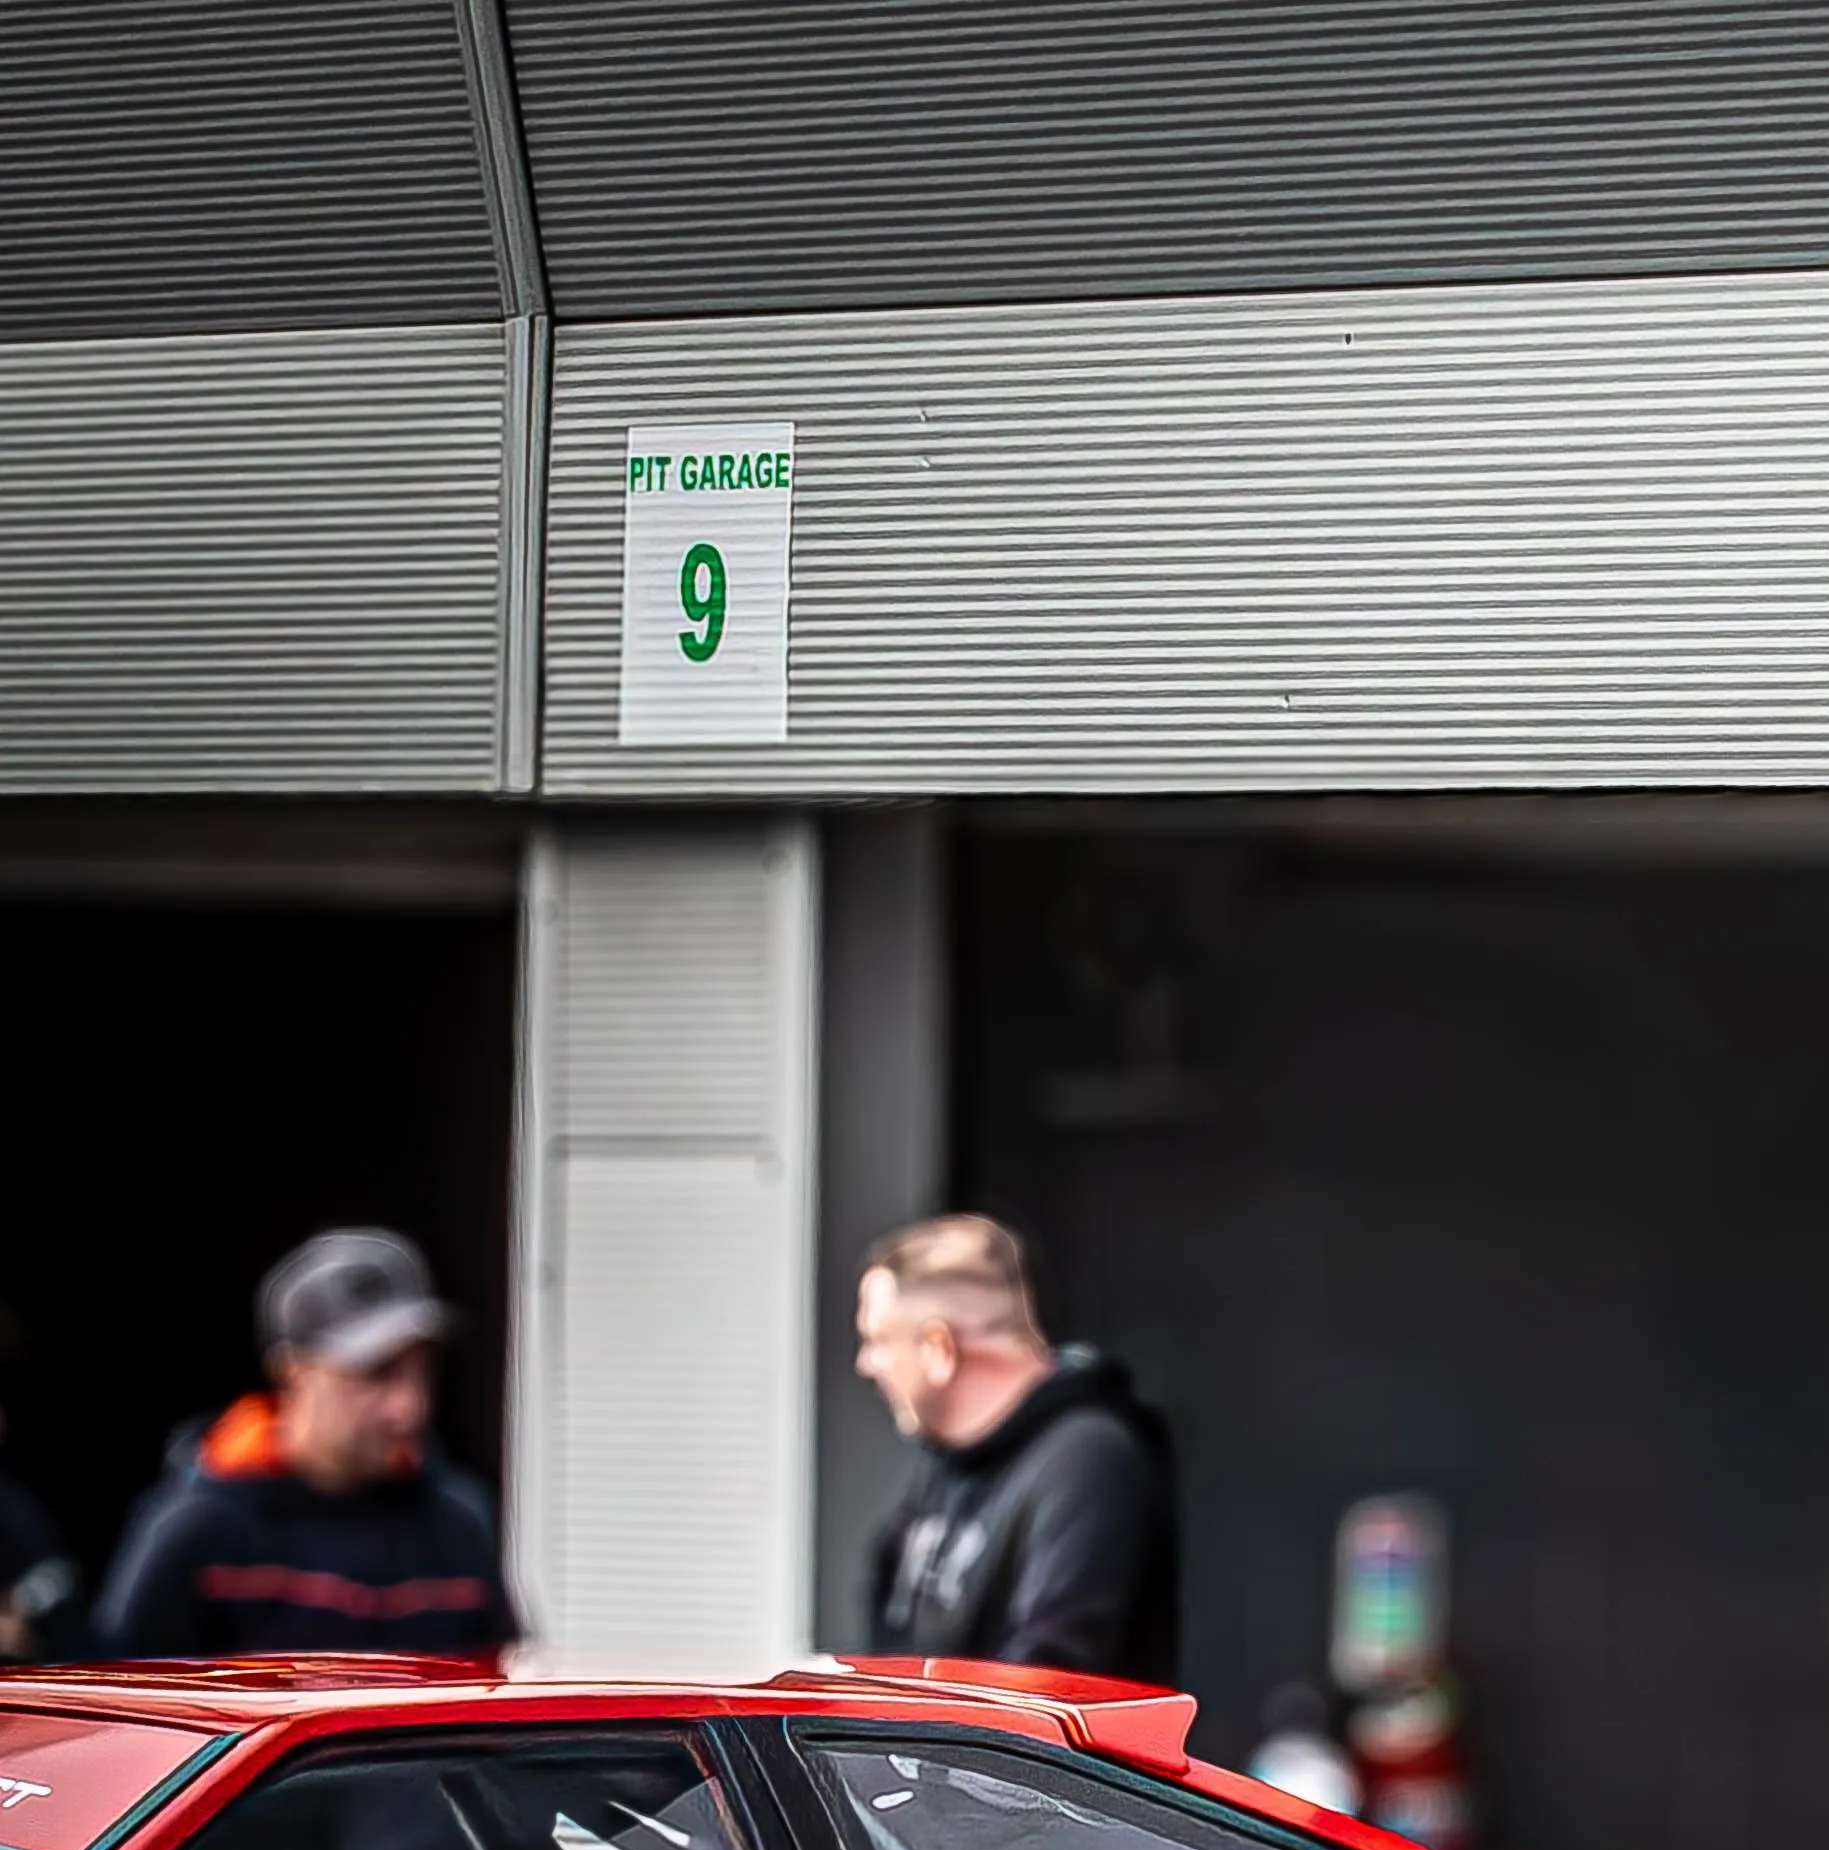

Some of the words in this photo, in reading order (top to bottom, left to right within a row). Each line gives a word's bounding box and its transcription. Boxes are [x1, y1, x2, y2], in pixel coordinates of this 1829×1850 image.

[629, 454, 671, 492] PIT
[679, 452, 790, 490] GARAGE
[677, 542, 728, 663] 9
